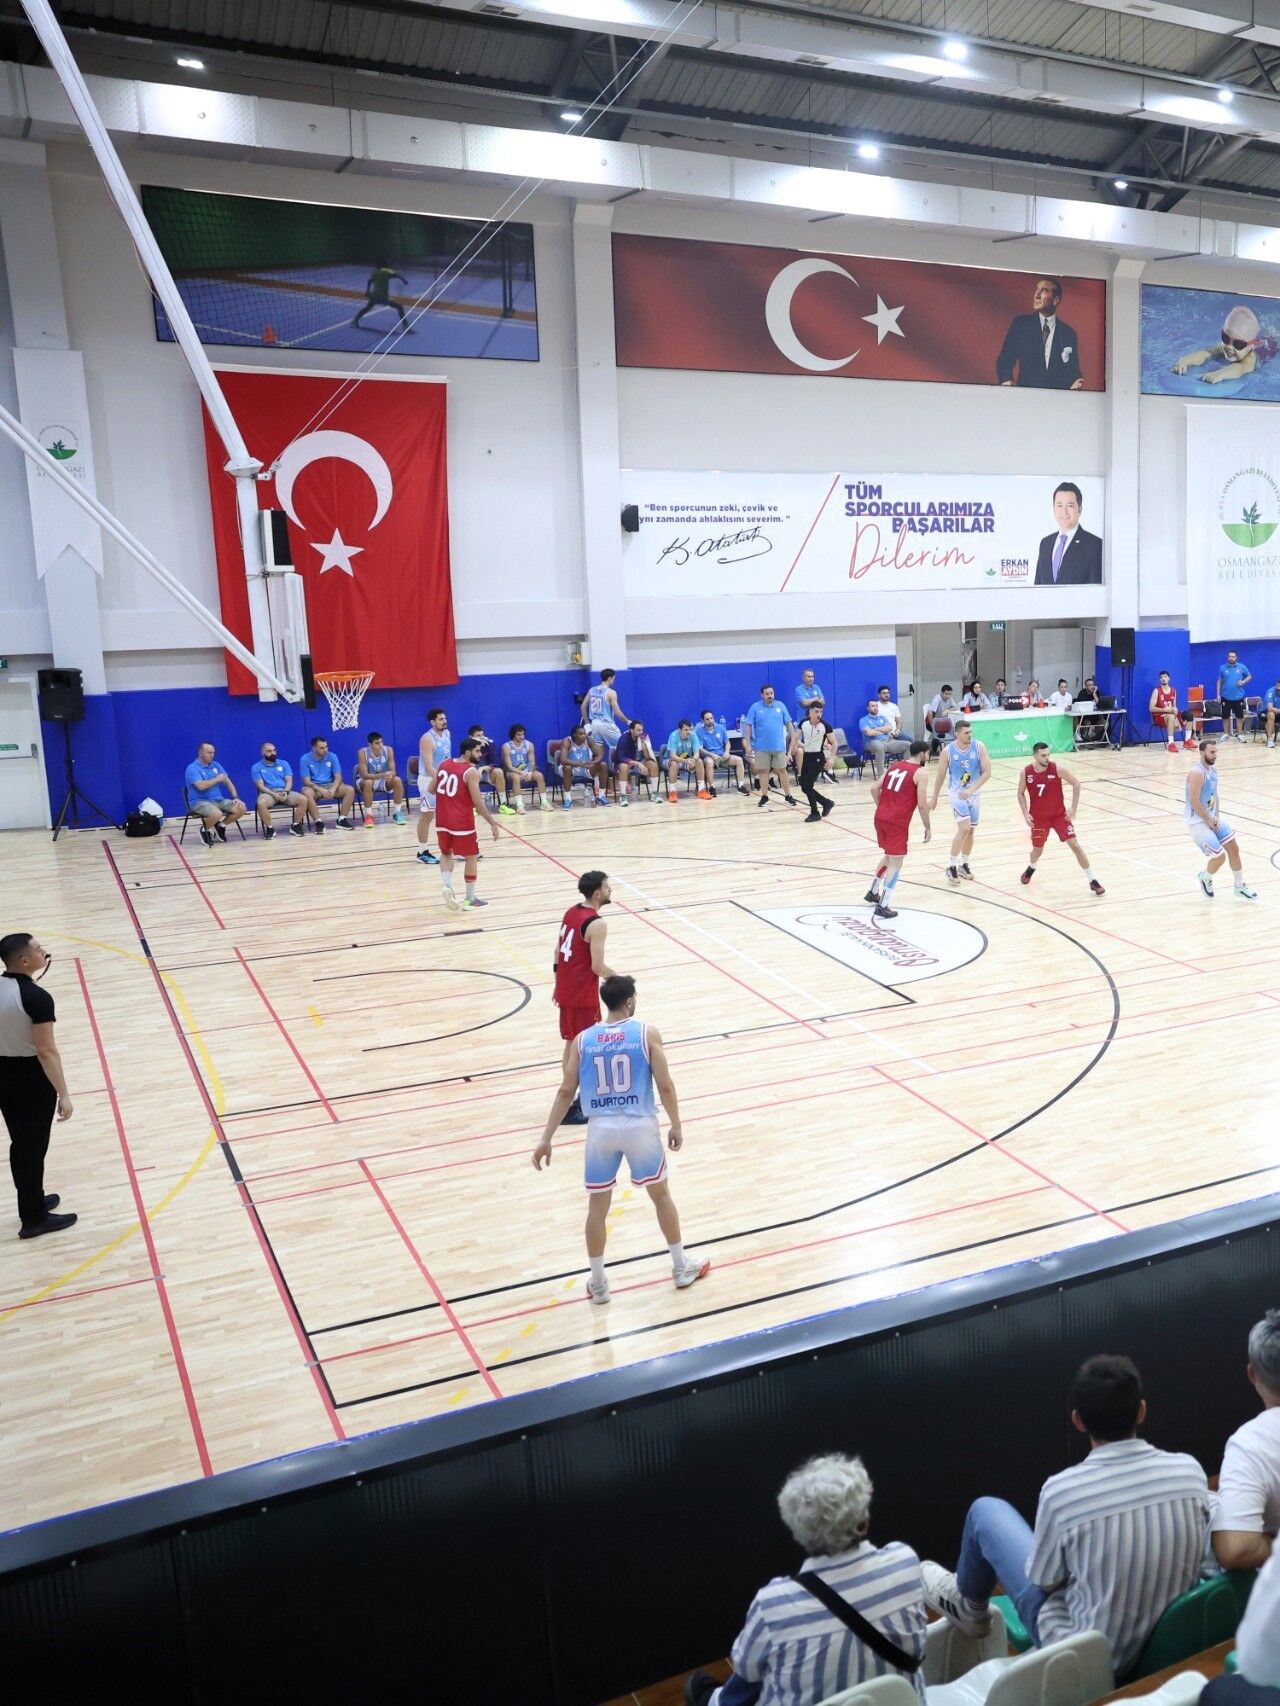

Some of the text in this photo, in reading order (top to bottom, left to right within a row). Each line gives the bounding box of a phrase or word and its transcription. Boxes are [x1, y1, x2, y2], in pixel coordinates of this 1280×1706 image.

[844, 481, 883, 500] TÜM
[669, 504, 717, 514] sporcunun
[719, 504, 740, 513] zeki,
[742, 504, 766, 514] çevik
[845, 501, 995, 517] SPORCULARIMIZA
[639, 516, 654, 524] ynı
[655, 515, 697, 523] zamanda
[699, 515, 745, 523] ahlaklısını
[892, 517, 995, 536] BAŞARILAR
[848, 521, 976, 579] Dilerim
[1001, 559, 1029, 567] ERKAN
[436, 769, 459, 797] 20
[887, 768, 908, 792] 11
[1036, 783, 1046, 797] 7
[592, 1053, 633, 1096] 10
